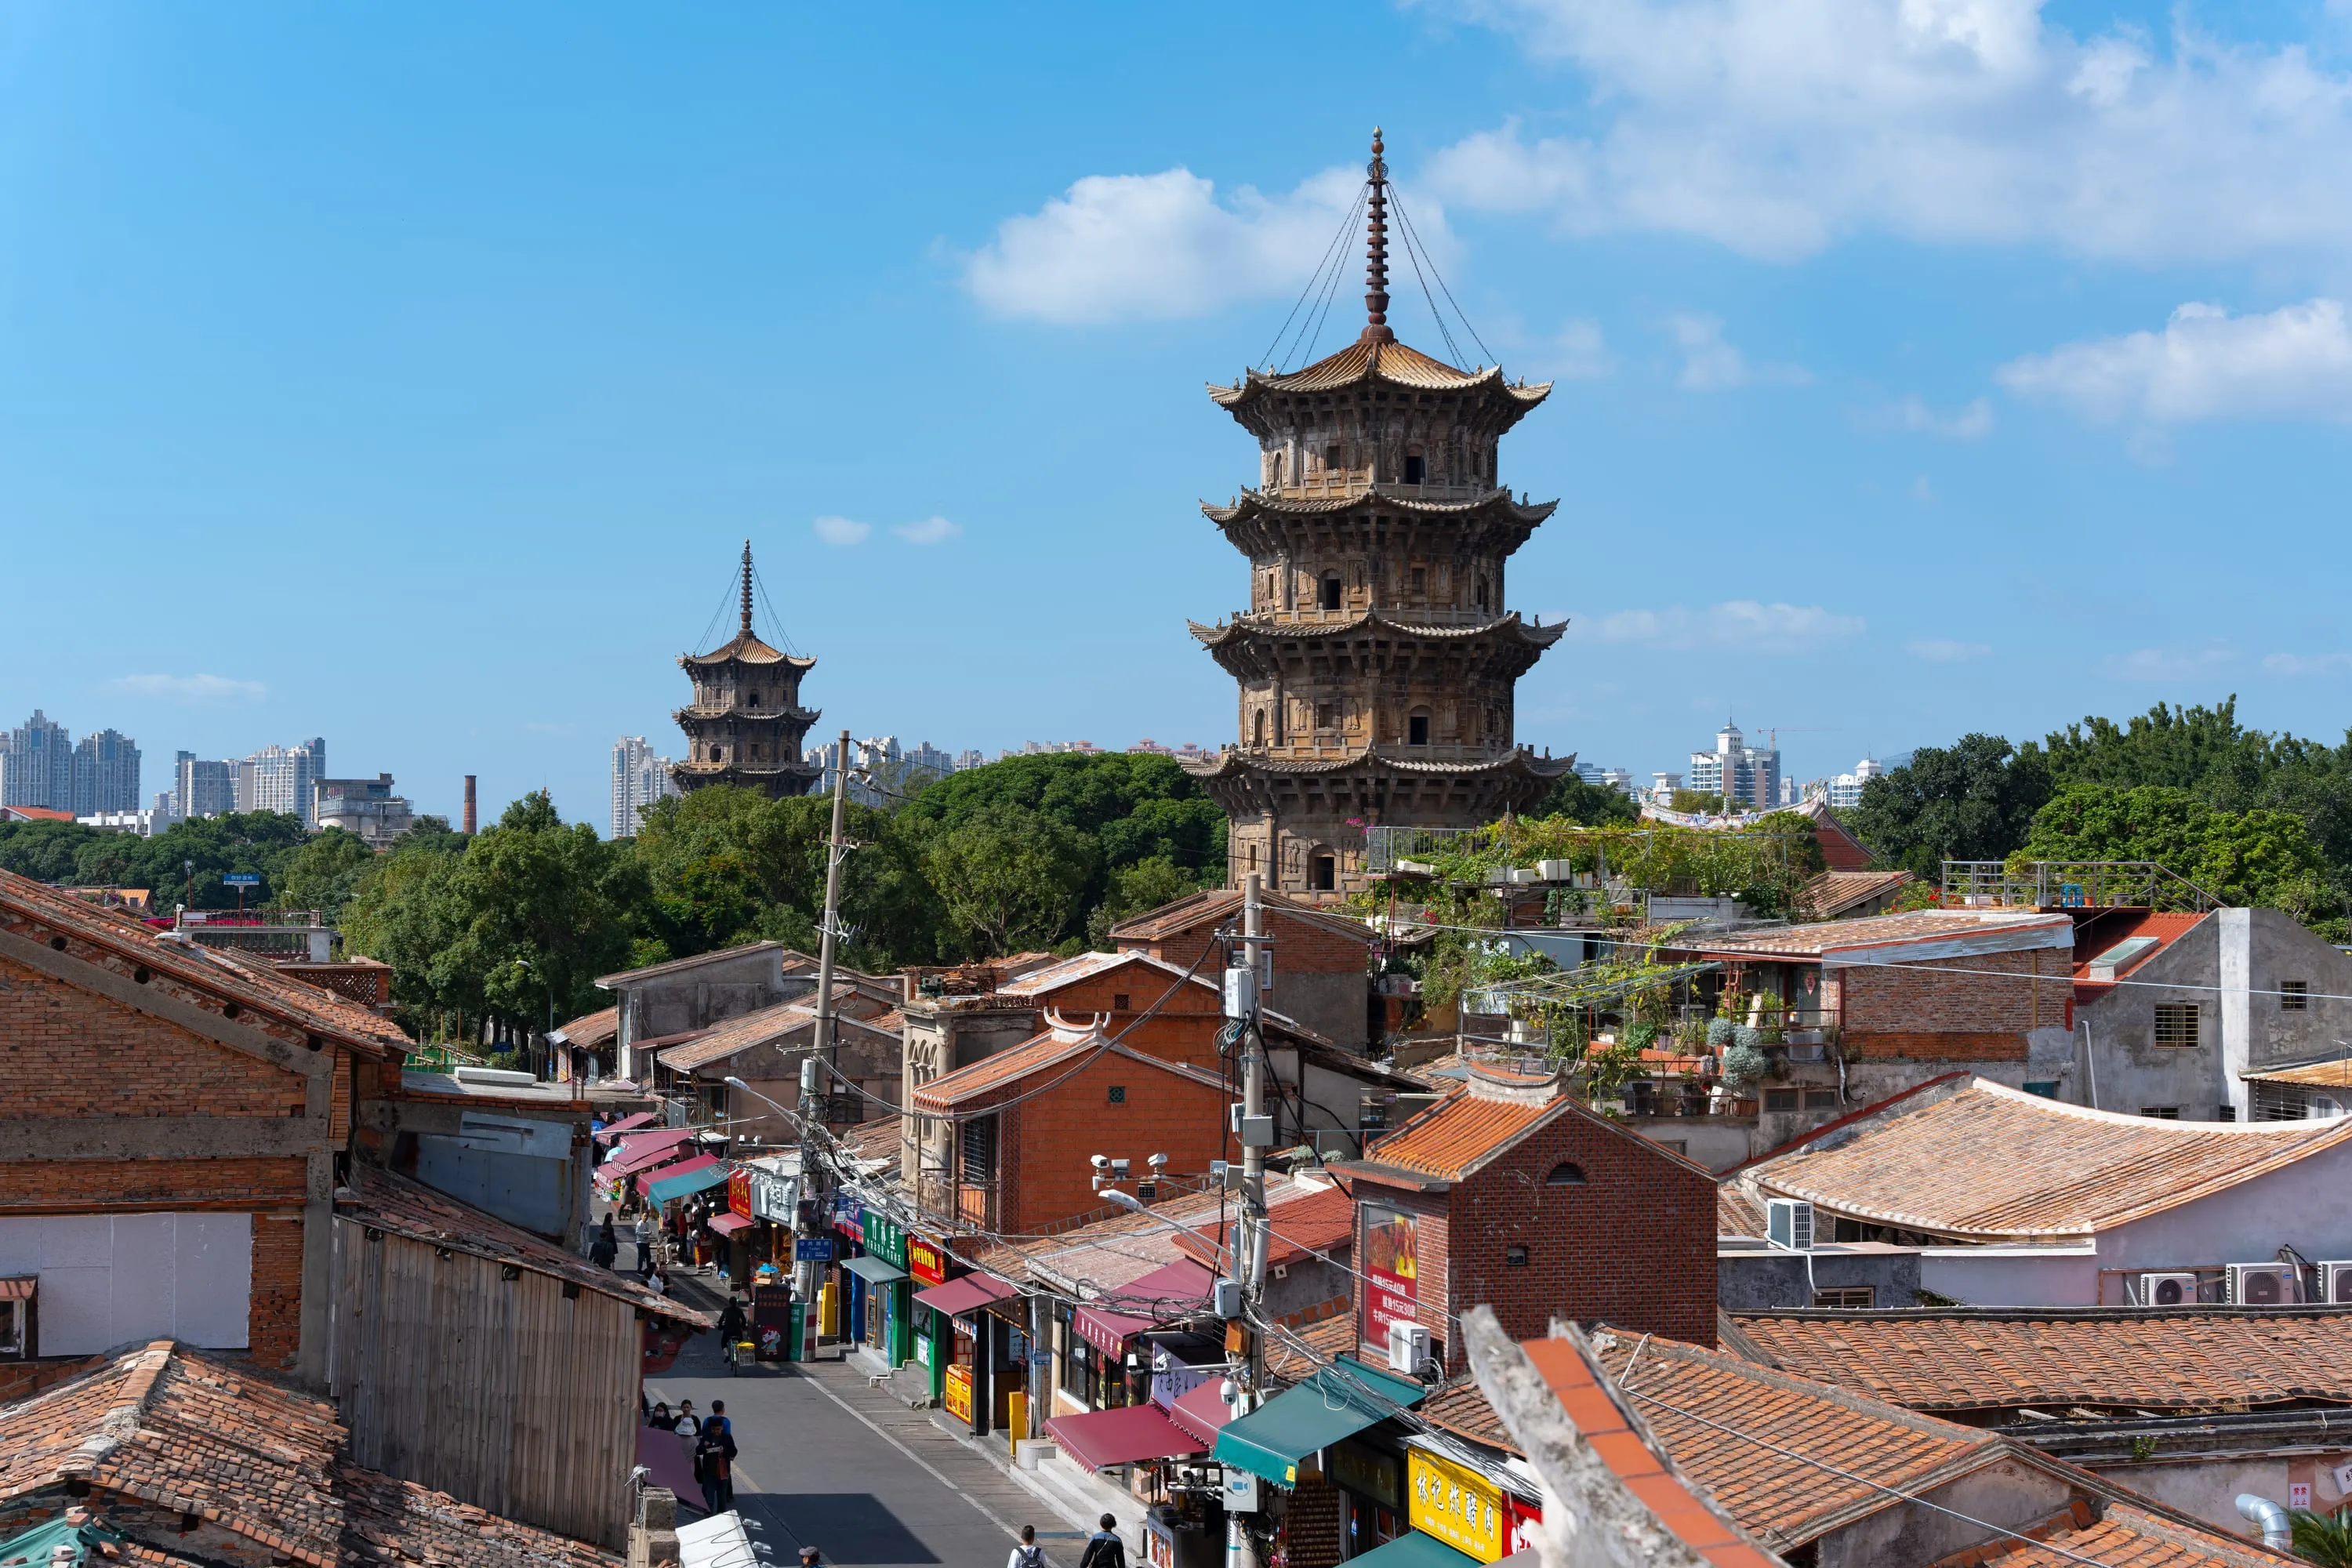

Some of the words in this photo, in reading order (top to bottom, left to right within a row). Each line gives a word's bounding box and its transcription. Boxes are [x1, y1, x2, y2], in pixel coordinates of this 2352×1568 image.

[1417, 1466, 1494, 1542] 林记炸醋肉
